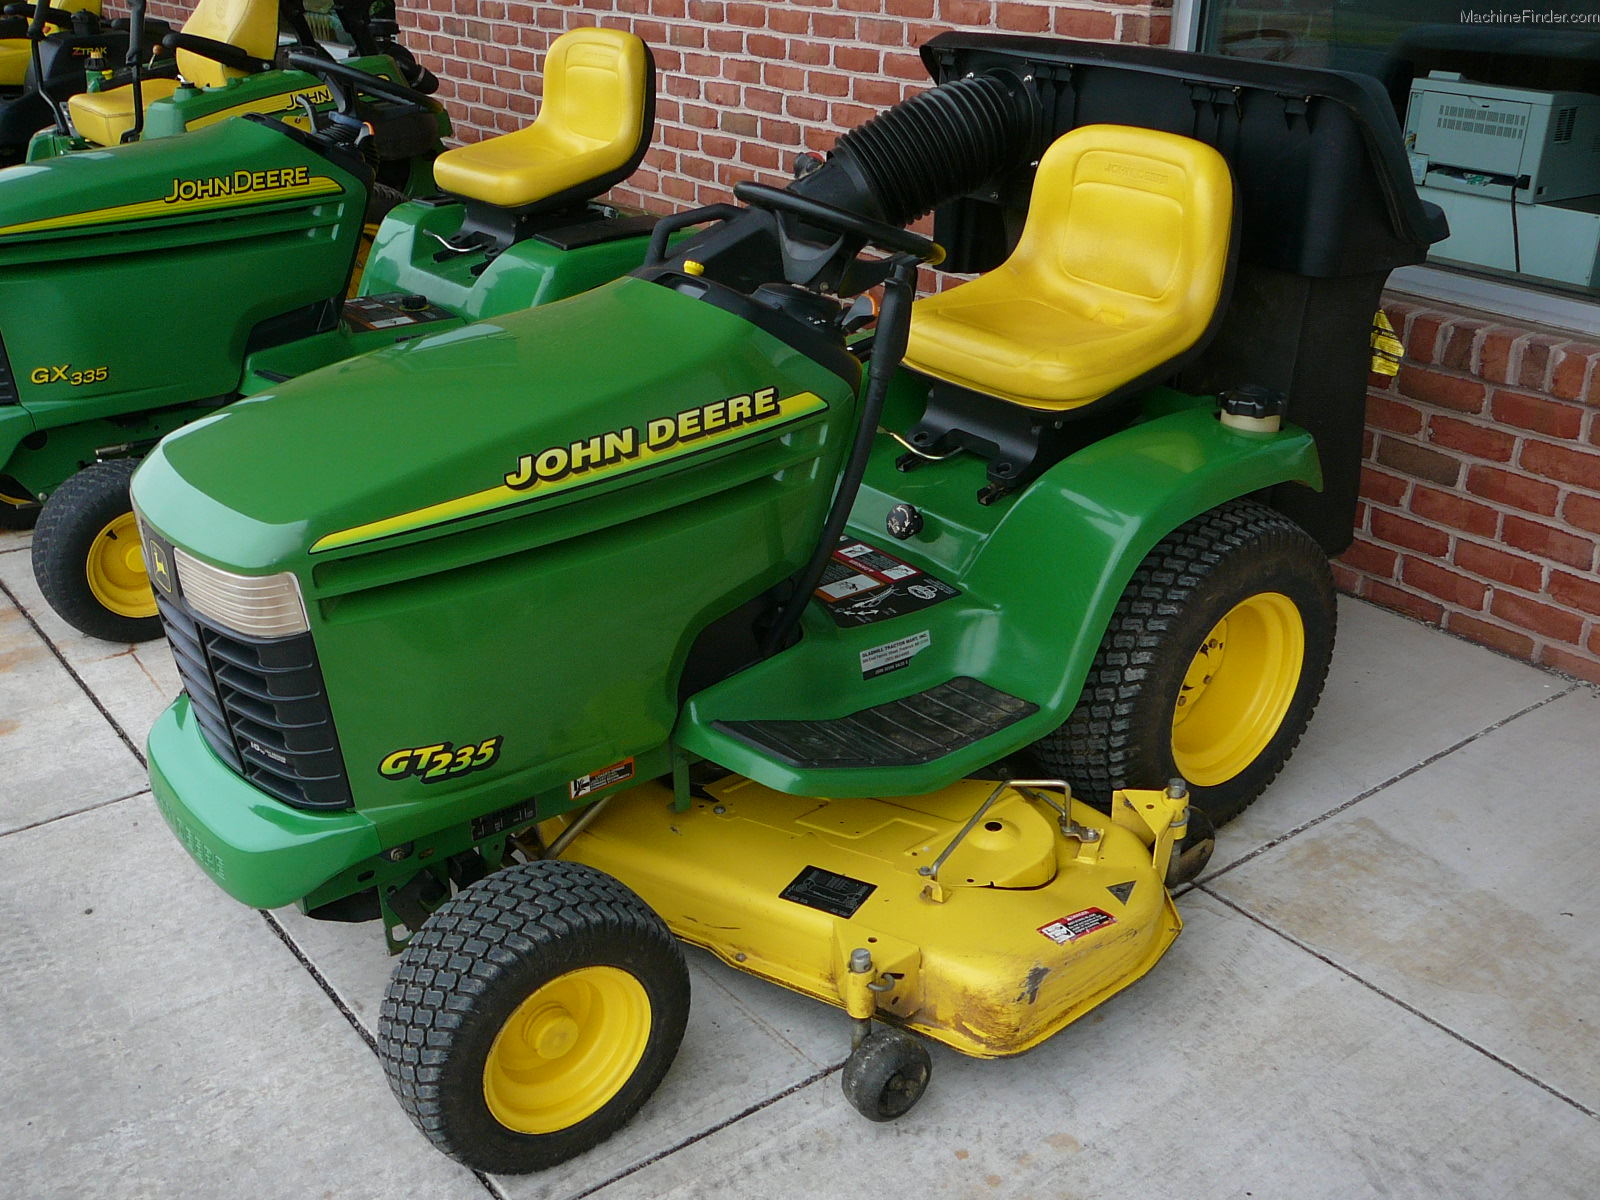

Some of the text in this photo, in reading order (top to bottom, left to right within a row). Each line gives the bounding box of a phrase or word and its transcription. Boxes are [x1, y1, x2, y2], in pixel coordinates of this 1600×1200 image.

[165, 166, 308, 203] JOHN DEERE
[504, 384, 782, 490] JOHN DEERE
[378, 735, 504, 784] GT235
